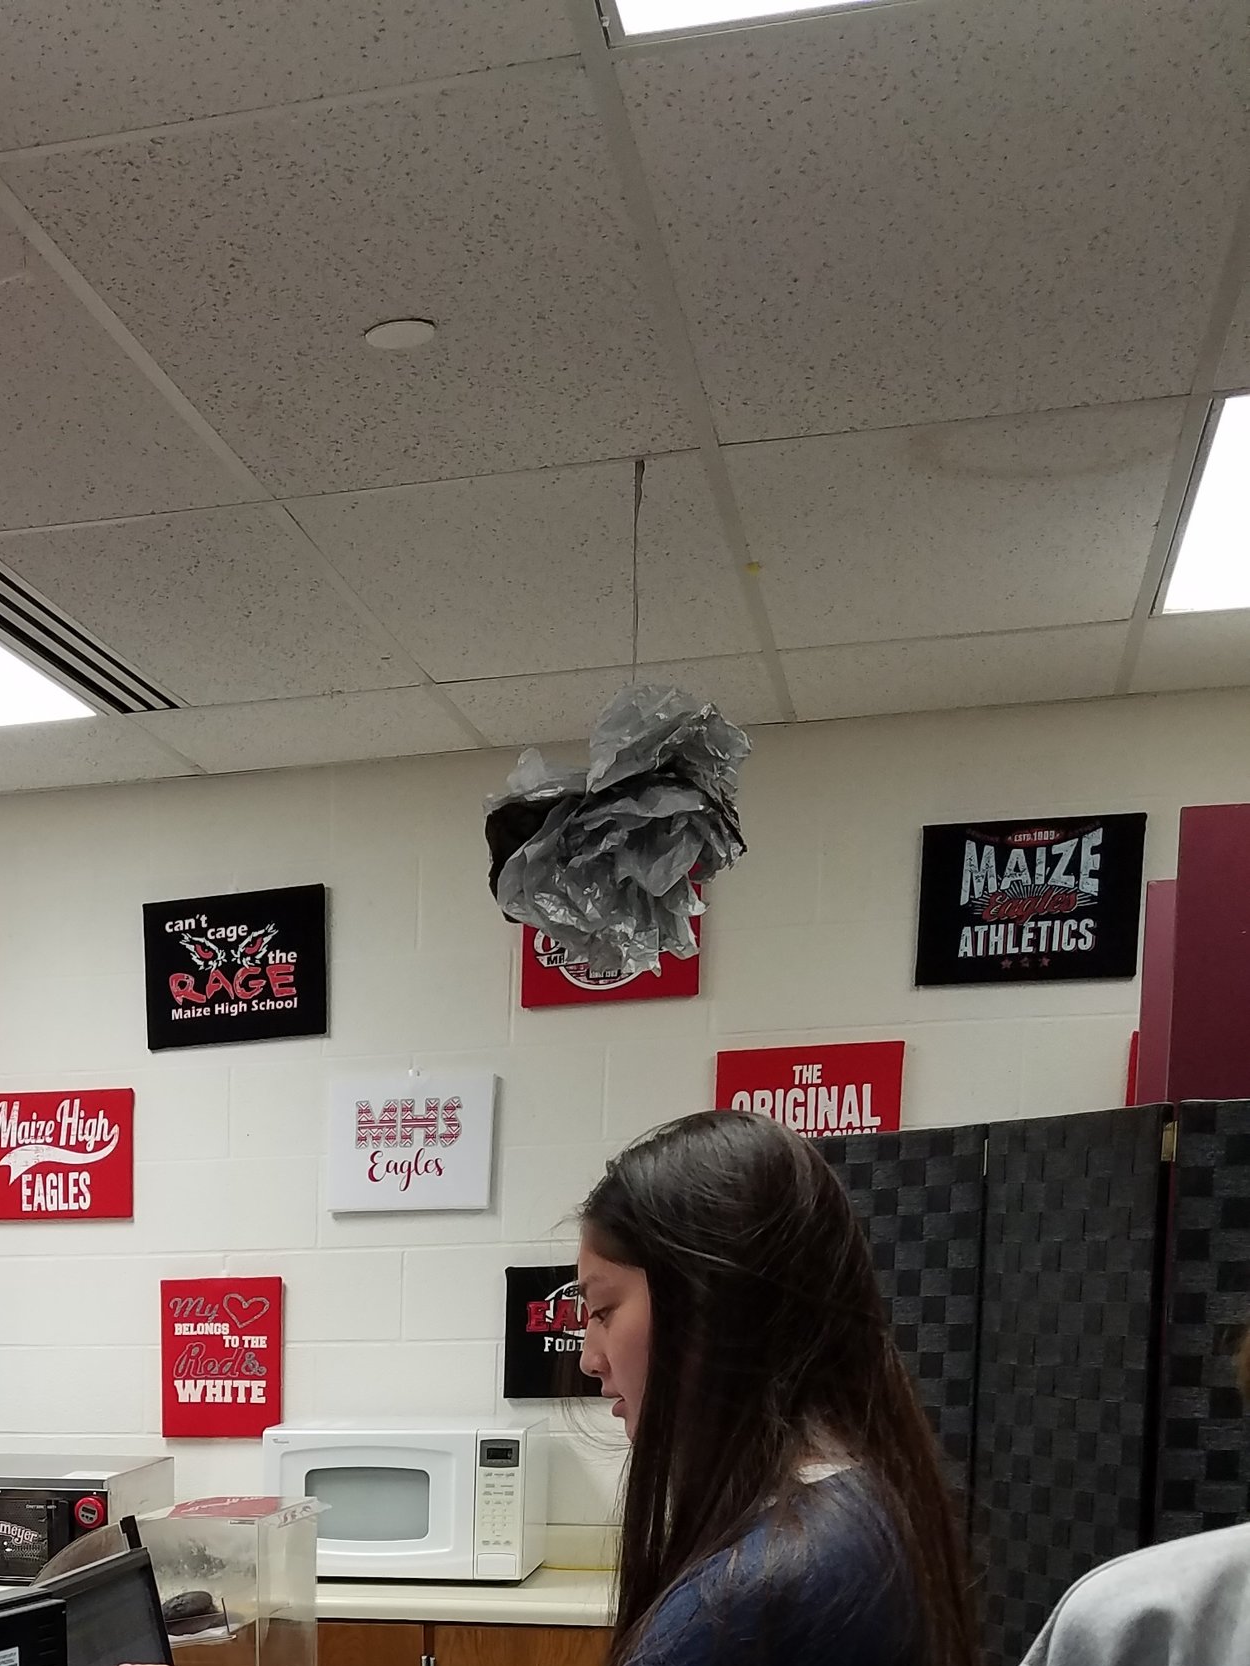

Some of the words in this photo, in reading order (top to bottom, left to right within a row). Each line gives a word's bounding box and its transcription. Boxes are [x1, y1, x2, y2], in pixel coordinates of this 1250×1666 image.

[960, 827, 1103, 906] MAIZE
[982, 888, 1078, 923] Eagles
[165, 914, 208, 933] can't
[207, 924, 248, 942] cage
[958, 918, 1097, 958] ATHLETICS
[267, 950, 298, 965] the
[169, 964, 297, 1006] RAGE
[171, 1005, 211, 1021] Maize
[214, 1001, 248, 1017] High
[251, 998, 298, 1012] School
[792, 1063, 823, 1085] THE
[56, 1099, 113, 1152] High
[355, 1096, 463, 1150] MHS
[367, 1148, 446, 1192] Eagles
[21, 1171, 91, 1211] EAGLES
[169, 1297, 219, 1323] My
[174, 1322, 230, 1335] BELONGS
[222, 1335, 240, 1348] TO
[242, 1335, 268, 1348] THE
[173, 1342, 245, 1379] Red
[174, 1379, 267, 1404] WHITE
